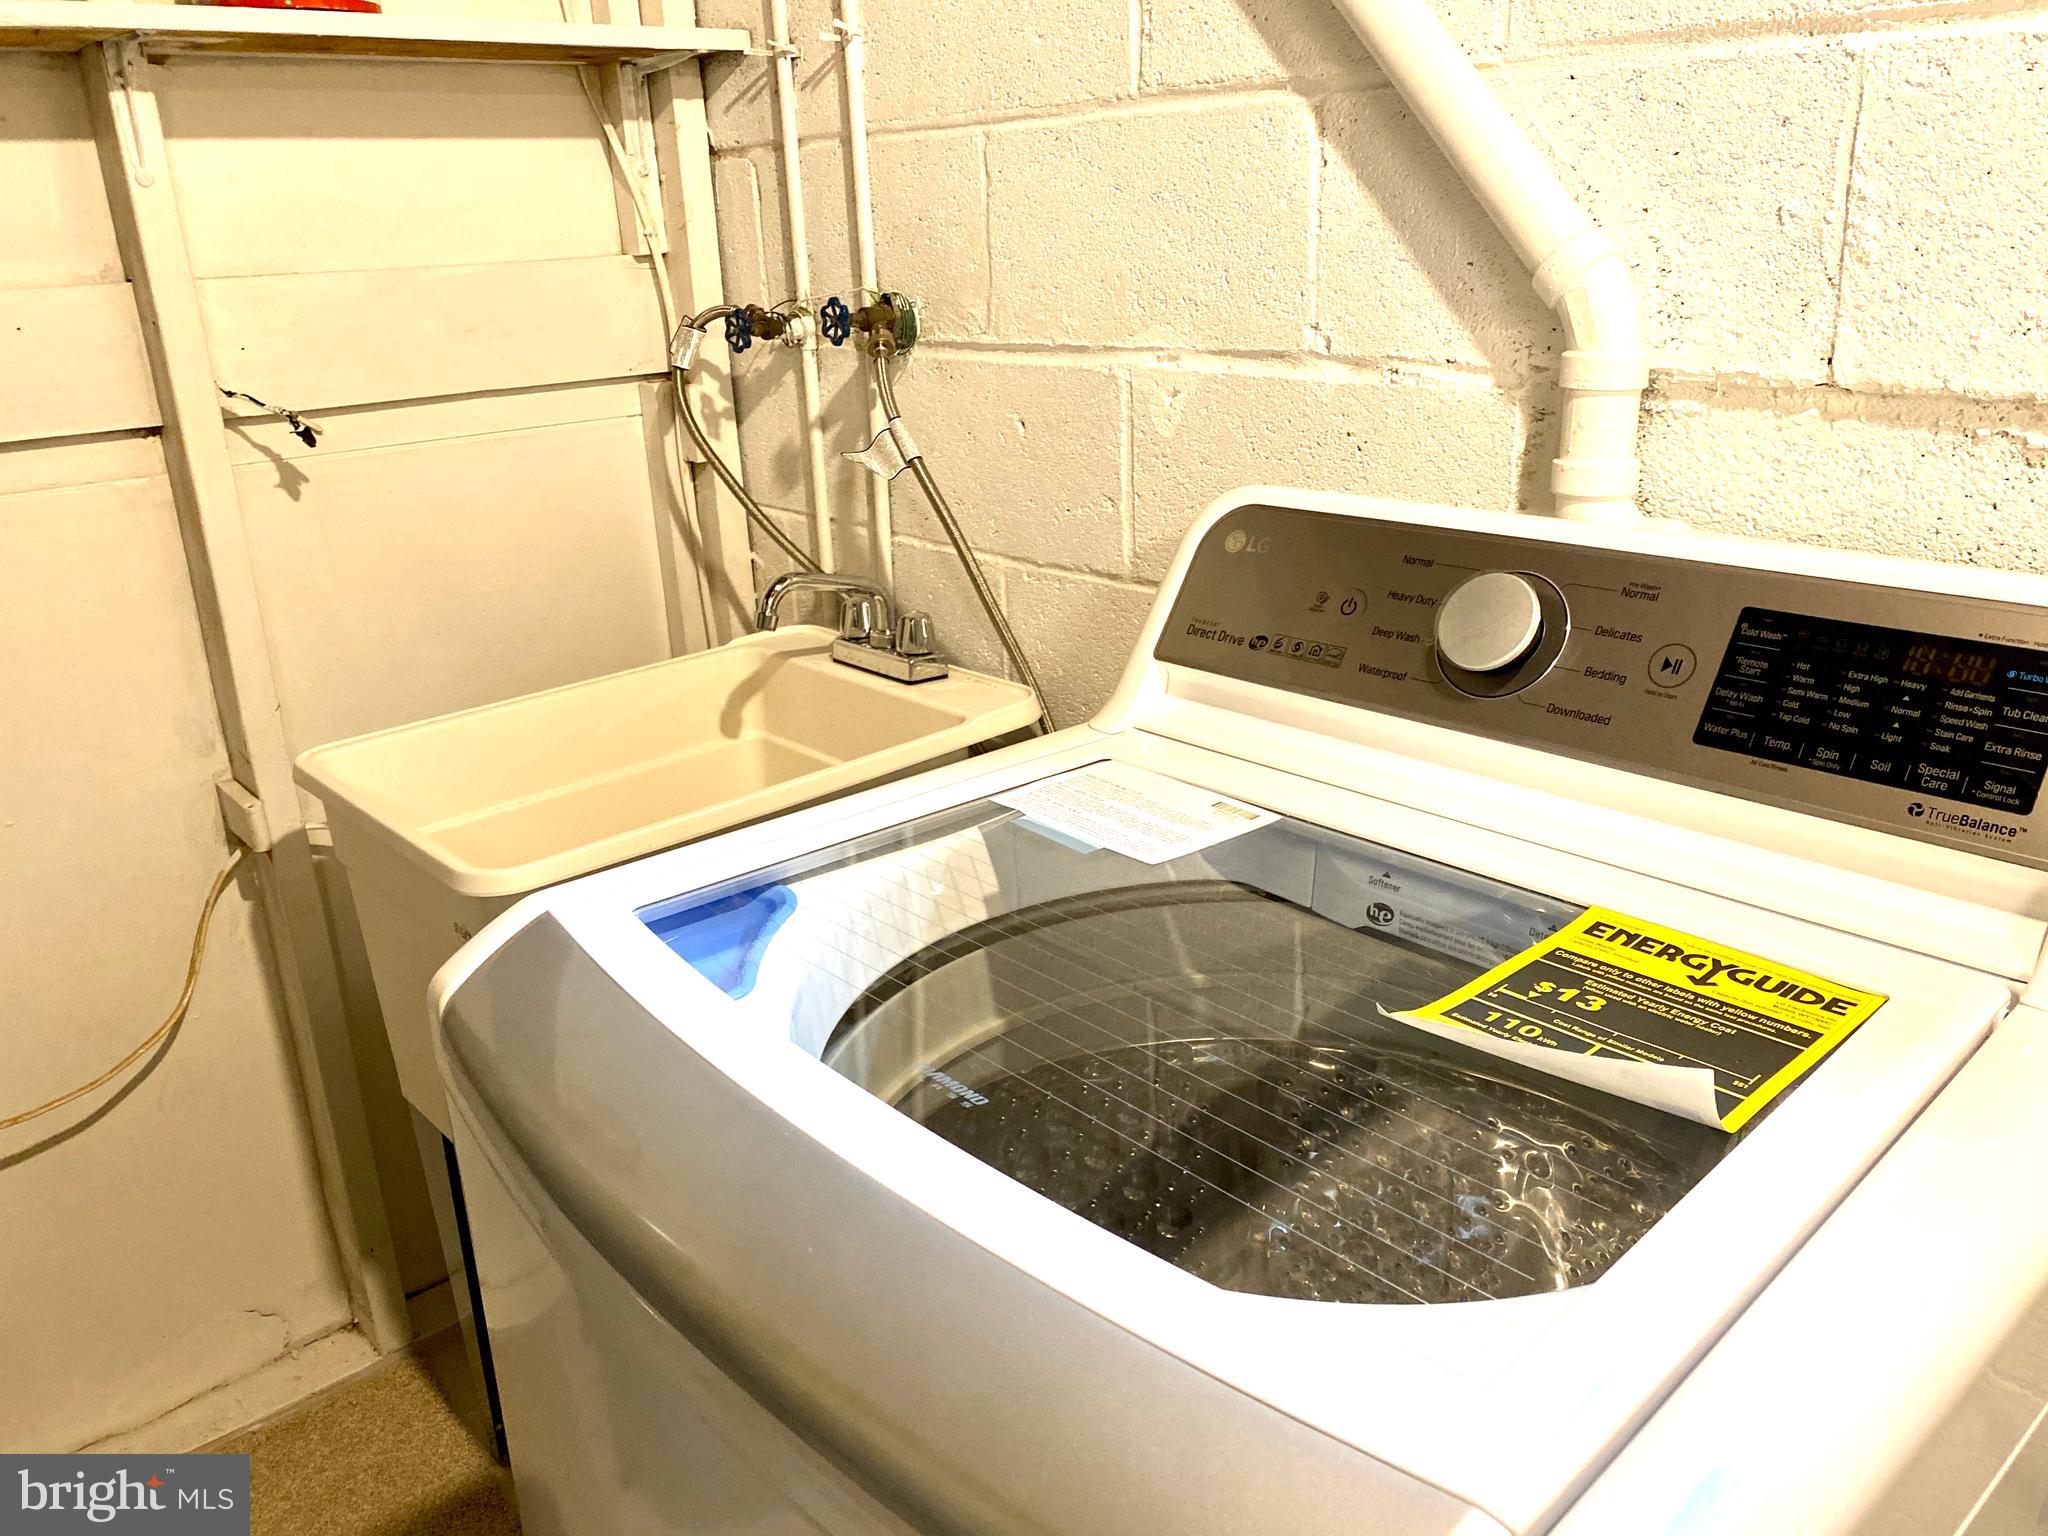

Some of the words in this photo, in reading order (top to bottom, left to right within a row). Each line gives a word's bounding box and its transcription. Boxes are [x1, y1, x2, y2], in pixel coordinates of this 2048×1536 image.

[1247, 536, 1271, 554] LG
[1402, 555, 1435, 567] Normal
[1387, 590, 1414, 603] Heavy
[1415, 594, 1438, 608] Duty
[1621, 586, 1660, 602] Normal
[1186, 623, 1217, 641] Direct
[1217, 630, 1245, 646] Drive
[1372, 626, 1394, 639] Deep
[1395, 631, 1421, 643] Wash
[1594, 625, 1643, 643] Delicates
[1741, 628, 1759, 637] Cold
[1738, 656, 1769, 669] Remote
[1797, 661, 1810, 670] Hot
[1359, 663, 1408, 681] Waterproof
[1583, 666, 1628, 686] Bedding
[1740, 665, 1762, 676] Start
[1848, 670, 1870, 680] Extra
[1870, 674, 1889, 685] High
[1793, 674, 1815, 684] Warm
[1900, 680, 1928, 692] Heavy
[1715, 687, 1738, 699] Delay
[1740, 692, 1763, 703] Wash
[1787, 687, 1805, 696] Semi
[1807, 690, 1829, 701] Warm
[1843, 683, 1861, 694] High
[1950, 688, 1964, 697] Add
[1782, 700, 1800, 709] Cold
[1838, 696, 1870, 708] Medium
[1546, 703, 1612, 726] Downloaded
[1779, 712, 1792, 722] Tap
[1793, 715, 1810, 725] Cold
[1833, 709, 1851, 719] Low
[1891, 706, 1922, 718] Normal
[2002, 706, 2021, 718] Tub
[1828, 722, 1840, 731] No
[1841, 724, 1859, 735] Spin
[1940, 715, 1965, 726] Speed
[1965, 720, 1988, 731] Wash
[1704, 723, 1729, 735] Water
[1731, 728, 1748, 739] Plus
[1881, 732, 1902, 743] Light
[1935, 728, 1955, 739] Stain
[1955, 733, 1974, 743] Care
[1764, 736, 1792, 751] Temp.
[1930, 742, 1951, 753] Soak
[1816, 747, 1840, 760] Spin
[1984, 742, 2012, 755] Extra
[2014, 747, 2042, 761] Rinse
[1870, 760, 1892, 772] Soil
[1917, 763, 1961, 781] Special
[1921, 777, 1948, 791] Care
[1984, 780, 2017, 795] Signal
[1976, 790, 2002, 802] Control
[2002, 796, 2021, 806] Lock
[1368, 875, 1402, 893] Softener
[1582, 921, 1858, 1016] ENERGYGUIDE
[1532, 982, 1607, 1011] $13
[1555, 950, 1598, 967] Compare
[1599, 966, 1622, 975] only
[1635, 978, 1663, 988] other
[1663, 986, 1695, 999] labels
[1697, 998, 1720, 1008] with
[1720, 1006, 1758, 1020] yellow
[1759, 1018, 1811, 1039] numbers.
[1584, 980, 1636, 999] Estimated
[1634, 997, 1669, 1011] Yearly
[1670, 1009, 1709, 1025] Energy
[1710, 1023, 1737, 1034] Cost
[1451, 1013, 1488, 1028] Estimated
[1488, 1027, 1512, 1037] Yearly
[1485, 1011, 1542, 1037] 110
[1537, 1036, 1557, 1046] kWh
[1553, 1019, 1572, 1028] Cost
[1572, 1026, 1596, 1037] Range
[1607, 1039, 1635, 1050] Similar
[1635, 1049, 1664, 1061] Models
